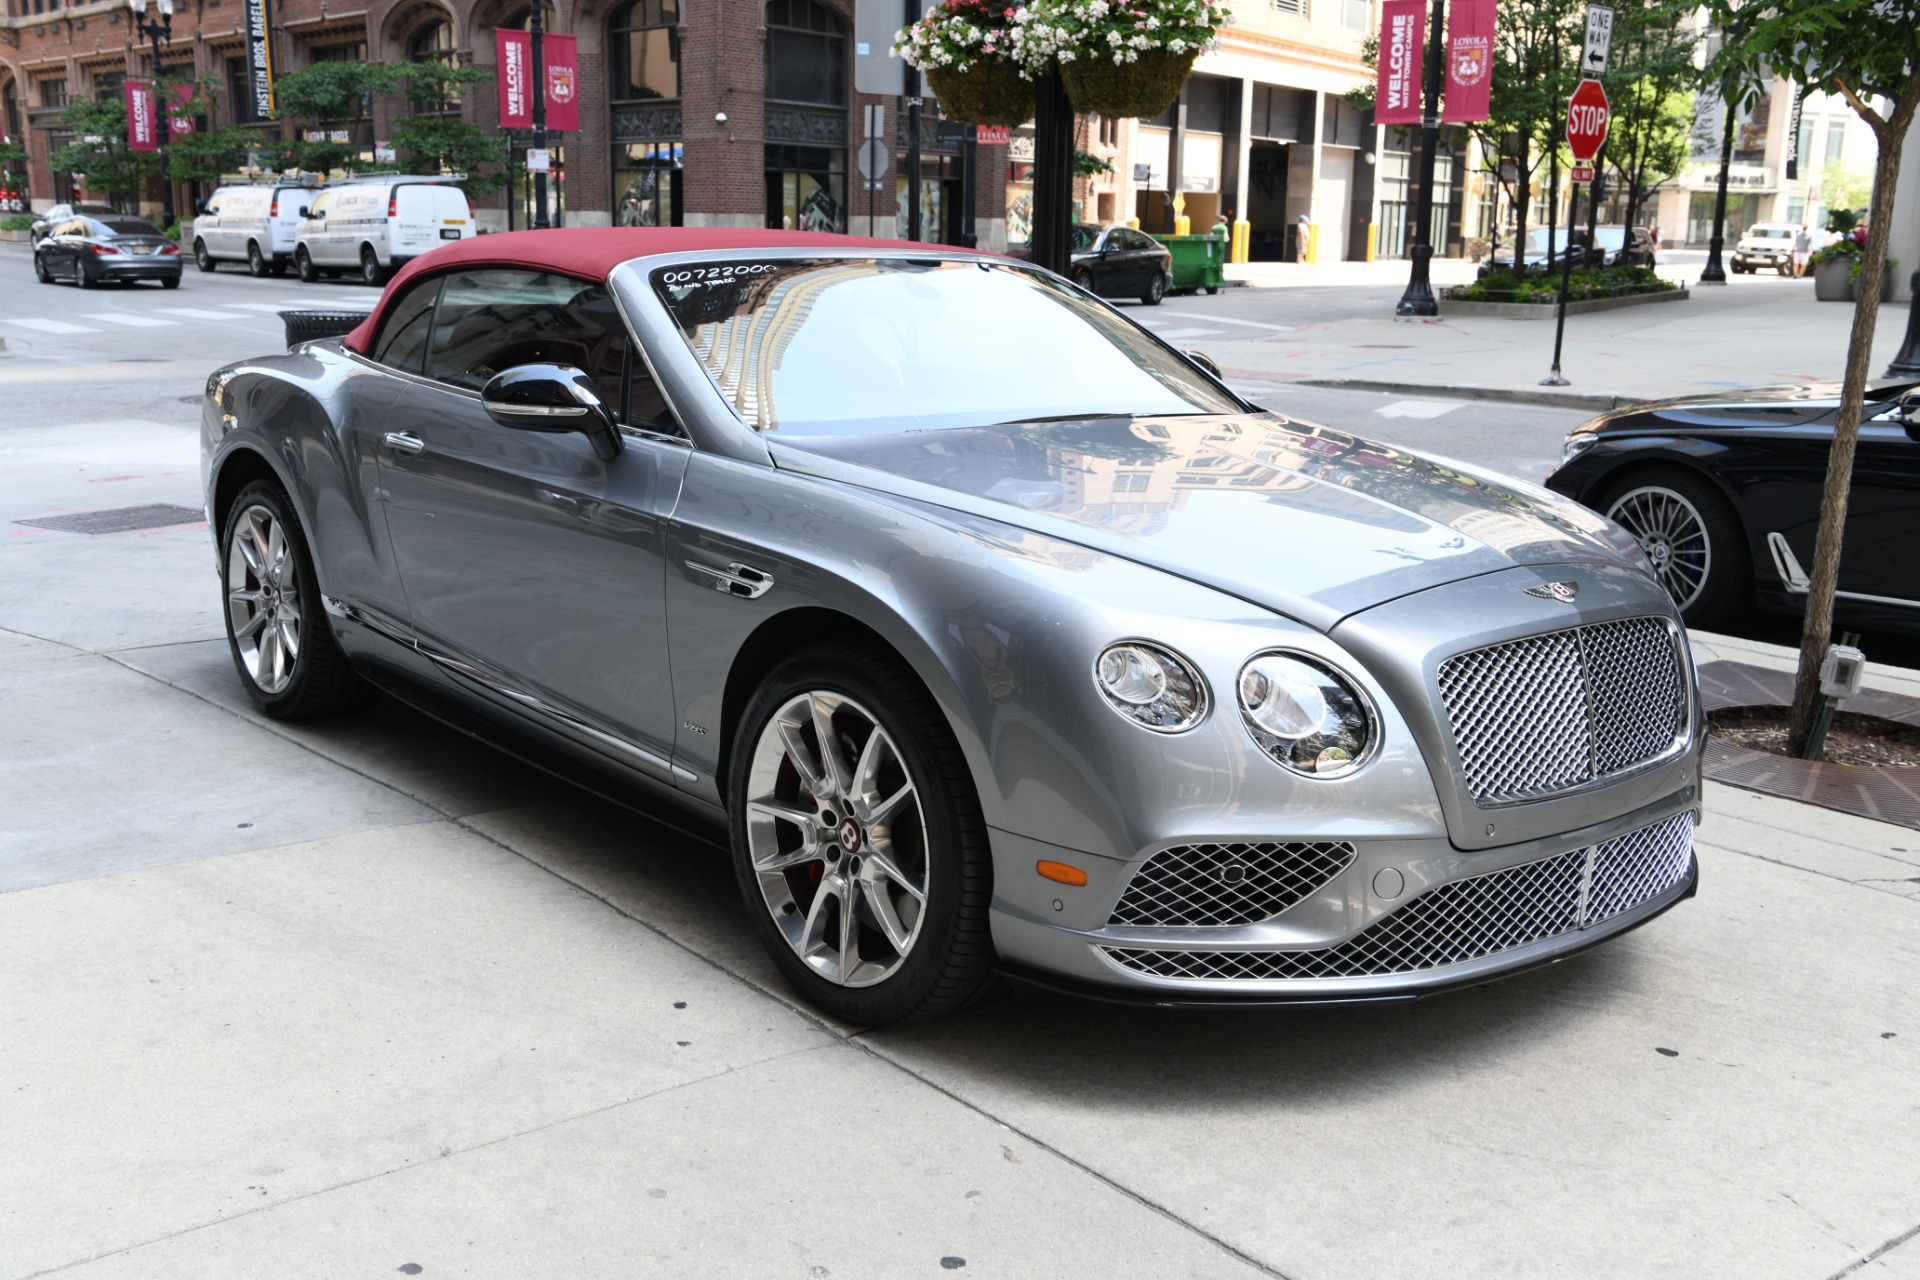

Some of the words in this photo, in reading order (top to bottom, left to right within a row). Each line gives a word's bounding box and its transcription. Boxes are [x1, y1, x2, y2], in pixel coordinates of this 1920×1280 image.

[1406, 14, 1415, 49] CAMPUS
[1591, 11, 1610, 29] ONE
[1453, 36, 1488, 46] LOYOLA
[1589, 31, 1608, 47] WAY
[1388, 14, 1406, 109] WELCOME
[1404, 50, 1412, 79] TOWER
[256, 70, 270, 117] EINSTEIN
[506, 41, 519, 116] WELCOME
[1402, 81, 1410, 109] WATER
[132, 90, 145, 142] WELCOME
[1569, 104, 1606, 136] STOP
